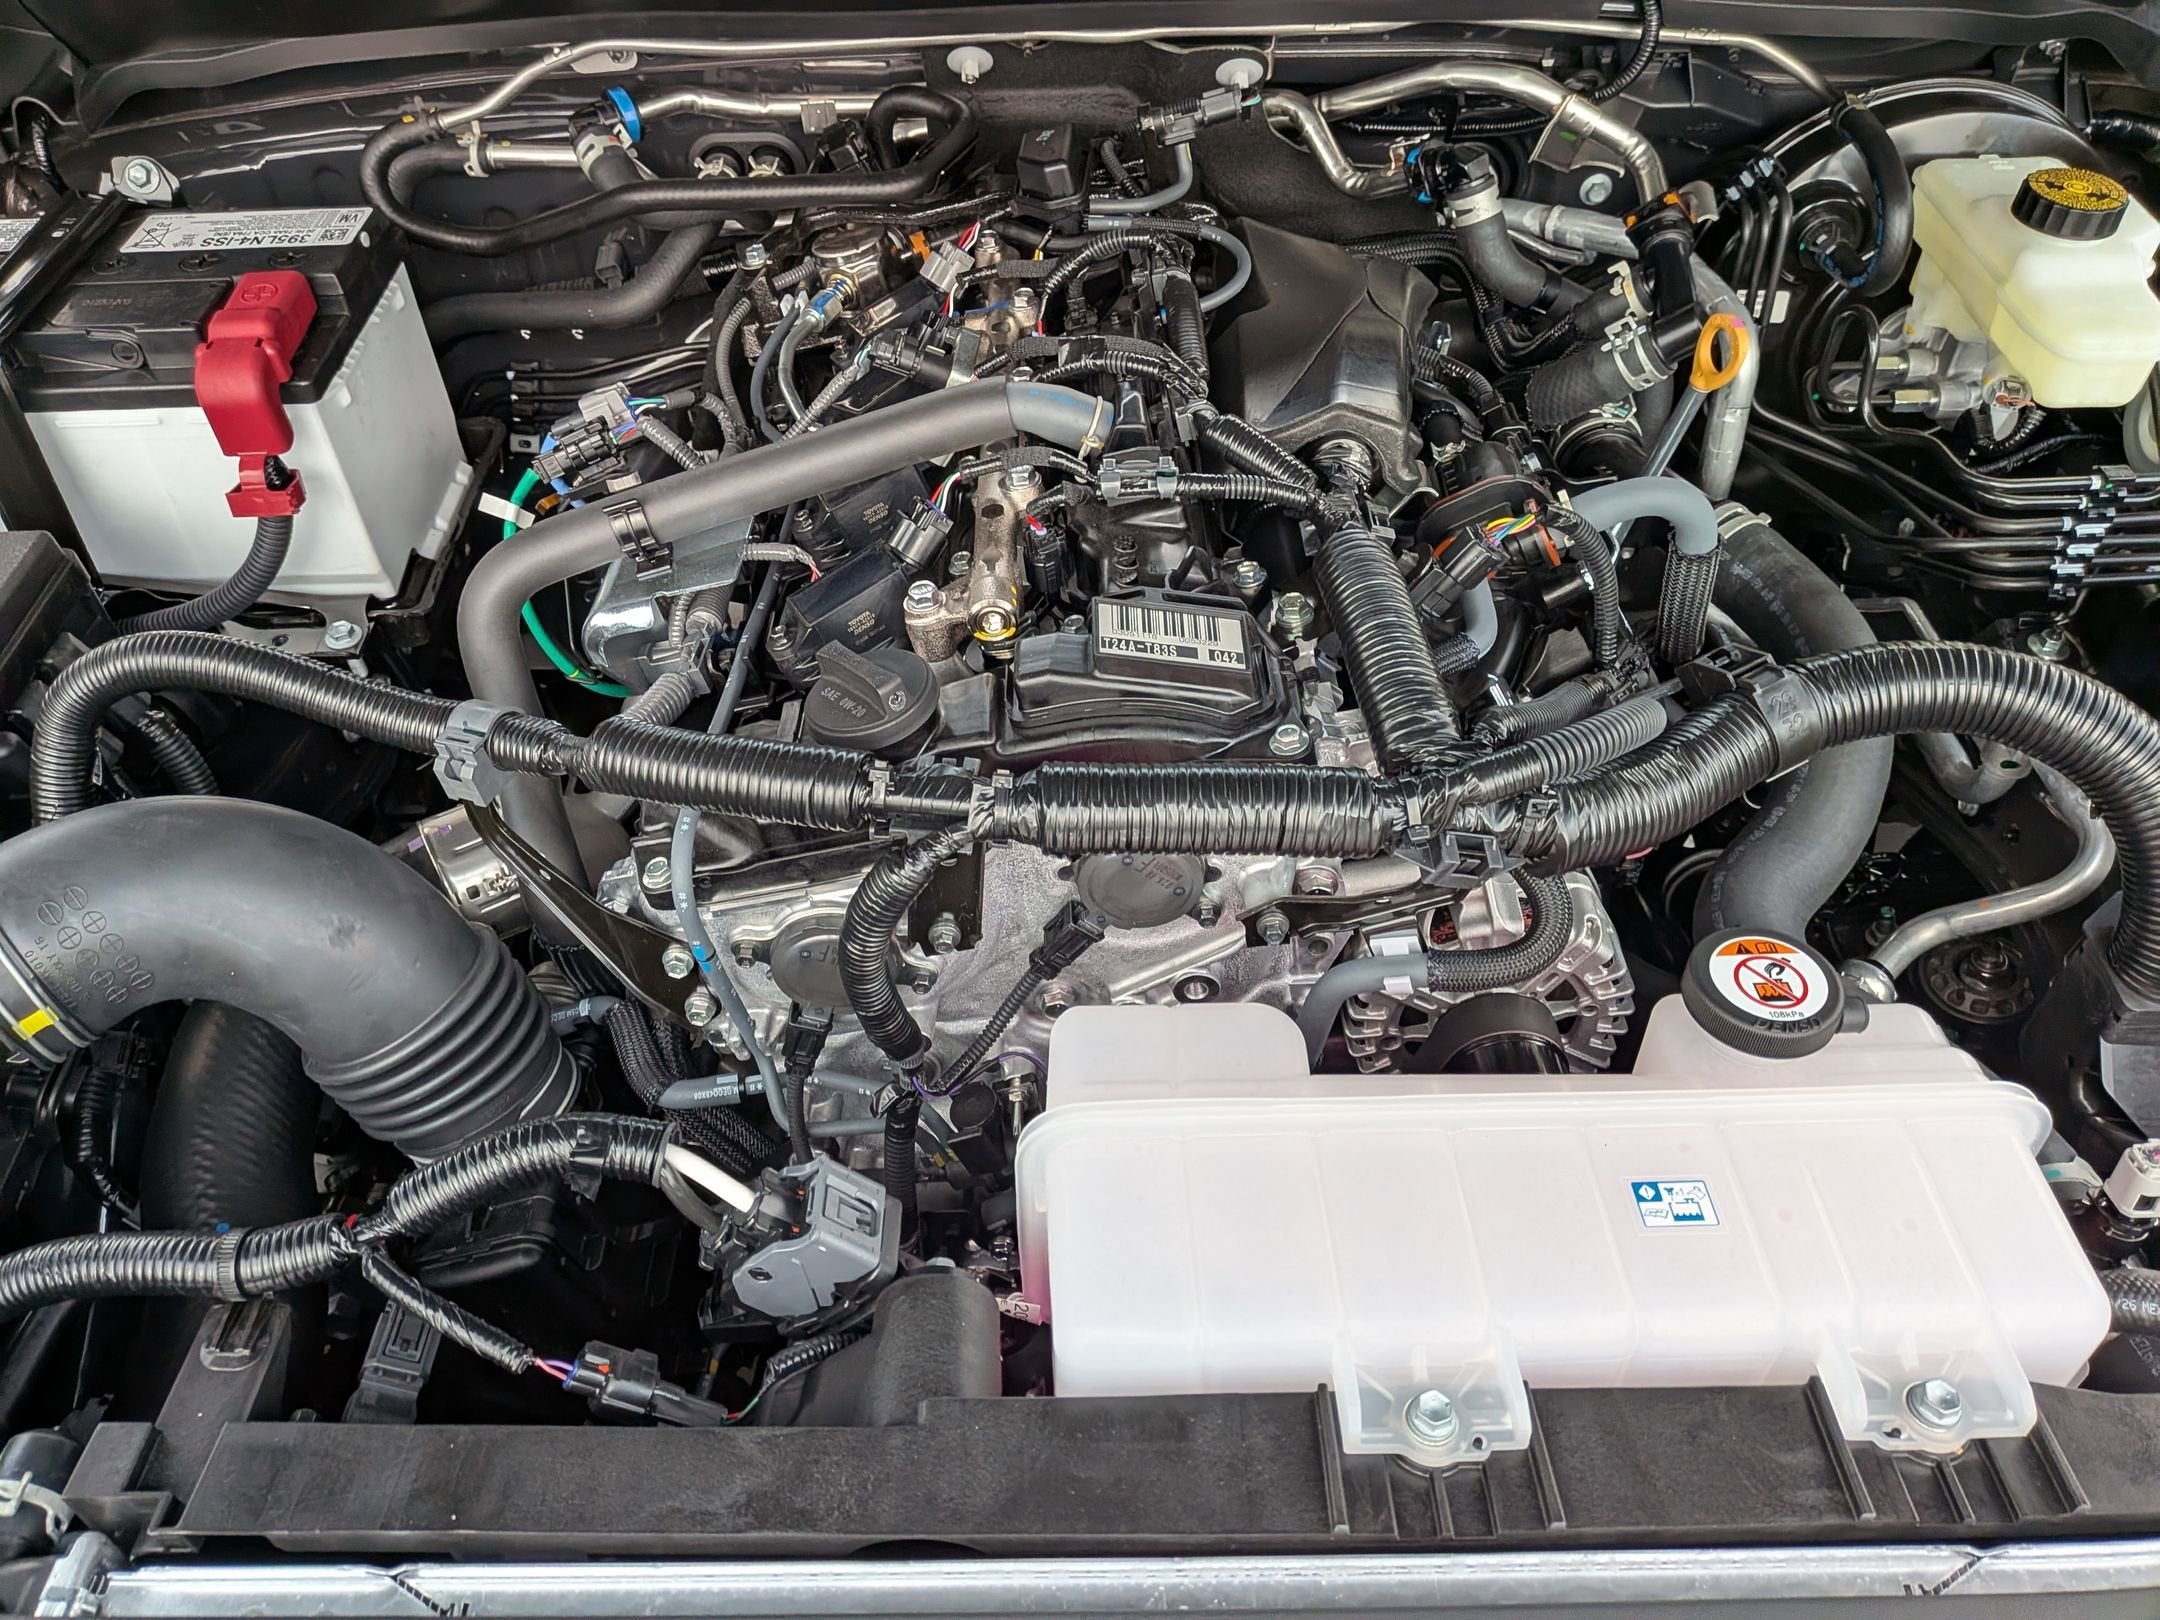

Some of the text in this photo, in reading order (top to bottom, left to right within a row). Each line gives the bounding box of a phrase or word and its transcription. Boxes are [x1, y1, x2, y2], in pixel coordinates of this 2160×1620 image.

[339, 214, 358, 223] VM
[200, 234, 311, 247] 395LN4-ISS
[863, 502, 885, 515] TOYOTA
[868, 510, 889, 524] DENSO
[848, 611, 871, 626] TOYOTA
[854, 619, 875, 636] DENSO
[1103, 637, 1238, 664] T24A-T83S 042
[821, 687, 866, 717] SAE 0W-20
[1769, 1010, 1805, 1019] 108kPa
